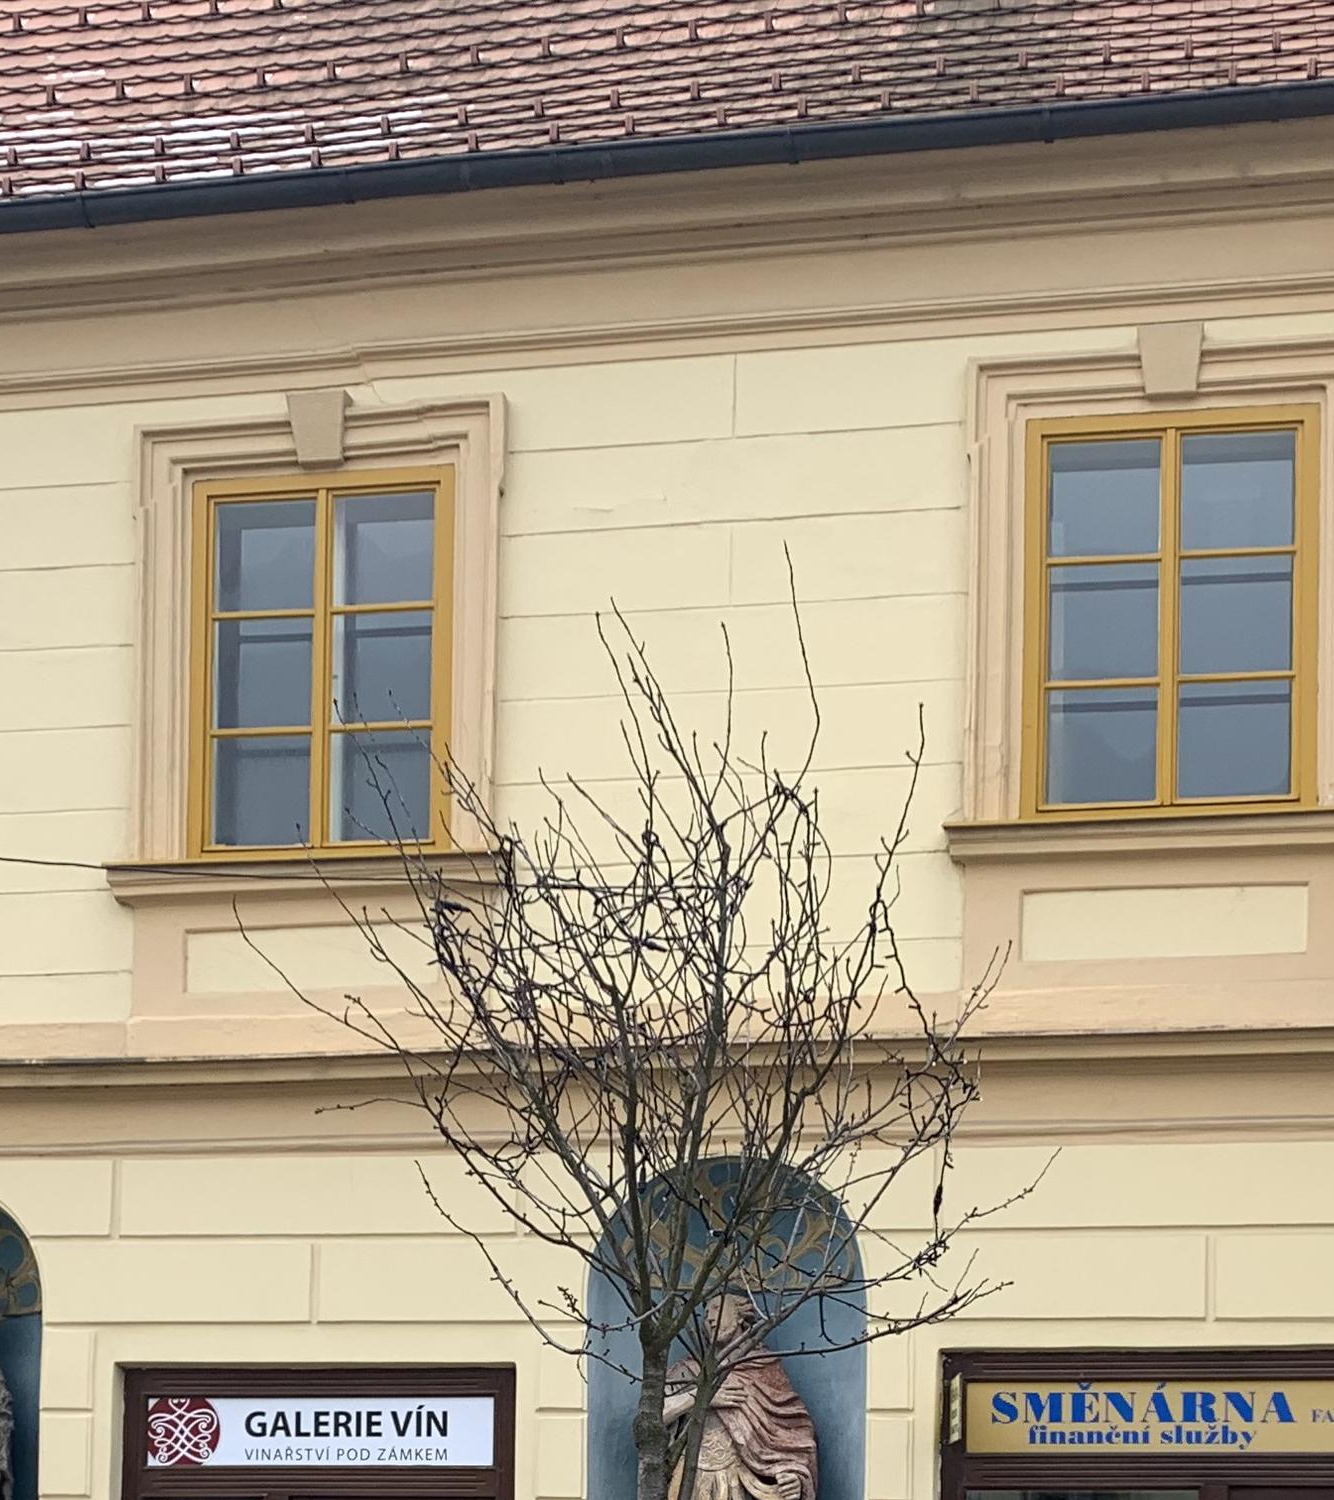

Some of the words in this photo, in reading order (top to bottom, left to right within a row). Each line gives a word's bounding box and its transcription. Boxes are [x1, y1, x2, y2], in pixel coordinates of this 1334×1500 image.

[991, 1381, 1296, 1424] SMĚNÁRNA
[244, 1410, 383, 1437] GALERIE
[390, 1404, 448, 1437] VÍN
[1029, 1424, 1150, 1445] finanční
[1160, 1424, 1257, 1450] služby
[244, 1446, 330, 1461] VINAŘSTVÍ
[336, 1448, 371, 1461] POD
[377, 1445, 448, 1461] ZÁMKEM
